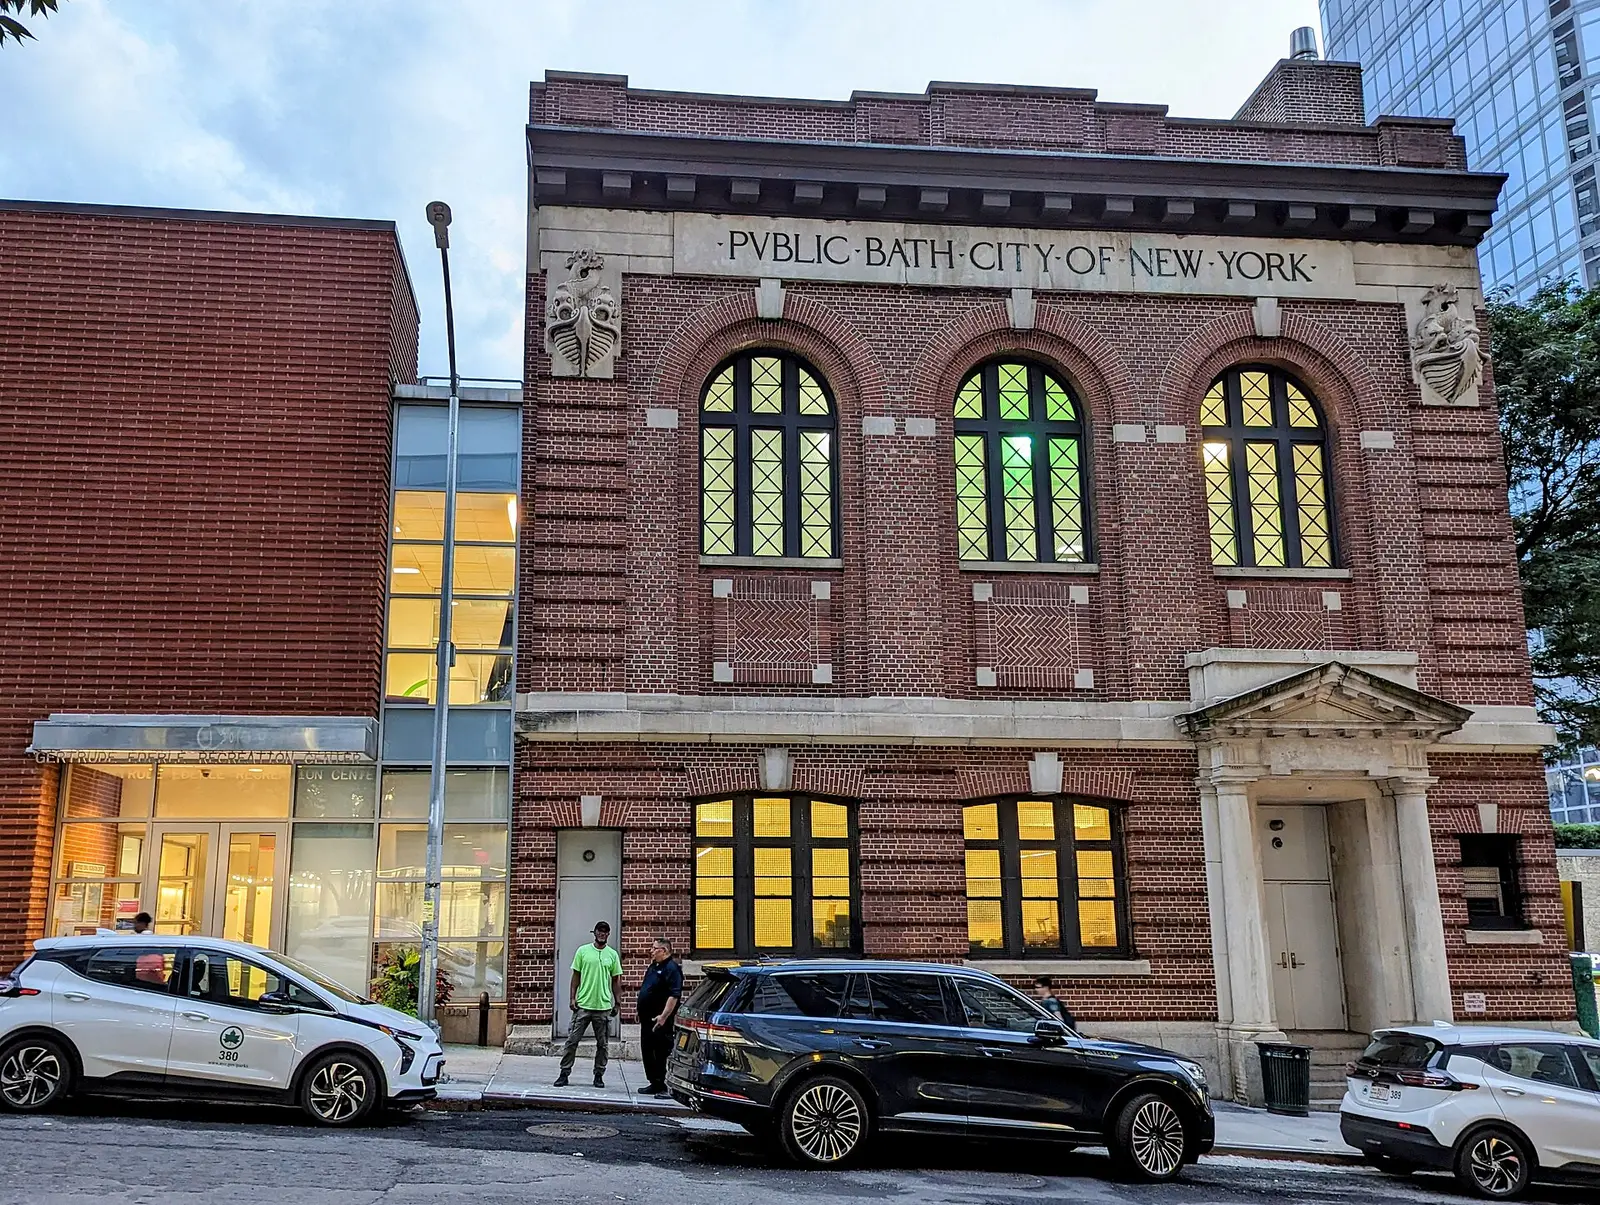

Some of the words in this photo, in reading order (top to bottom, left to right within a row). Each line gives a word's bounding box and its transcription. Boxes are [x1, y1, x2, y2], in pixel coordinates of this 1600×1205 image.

[729, 230, 850, 265] PVBLIC
[865, 237, 954, 269] BATH
[969, 241, 1055, 274] CITY
[1066, 246, 1115, 275] OF
[1129, 247, 1203, 279] NEW
[1217, 250, 1312, 283] YORK
[35, 751, 117, 764] GERTRUDE
[199, 751, 295, 764] RECREATION
[218, 1050, 239, 1061] 380
[1390, 1090, 1402, 1100] 389
